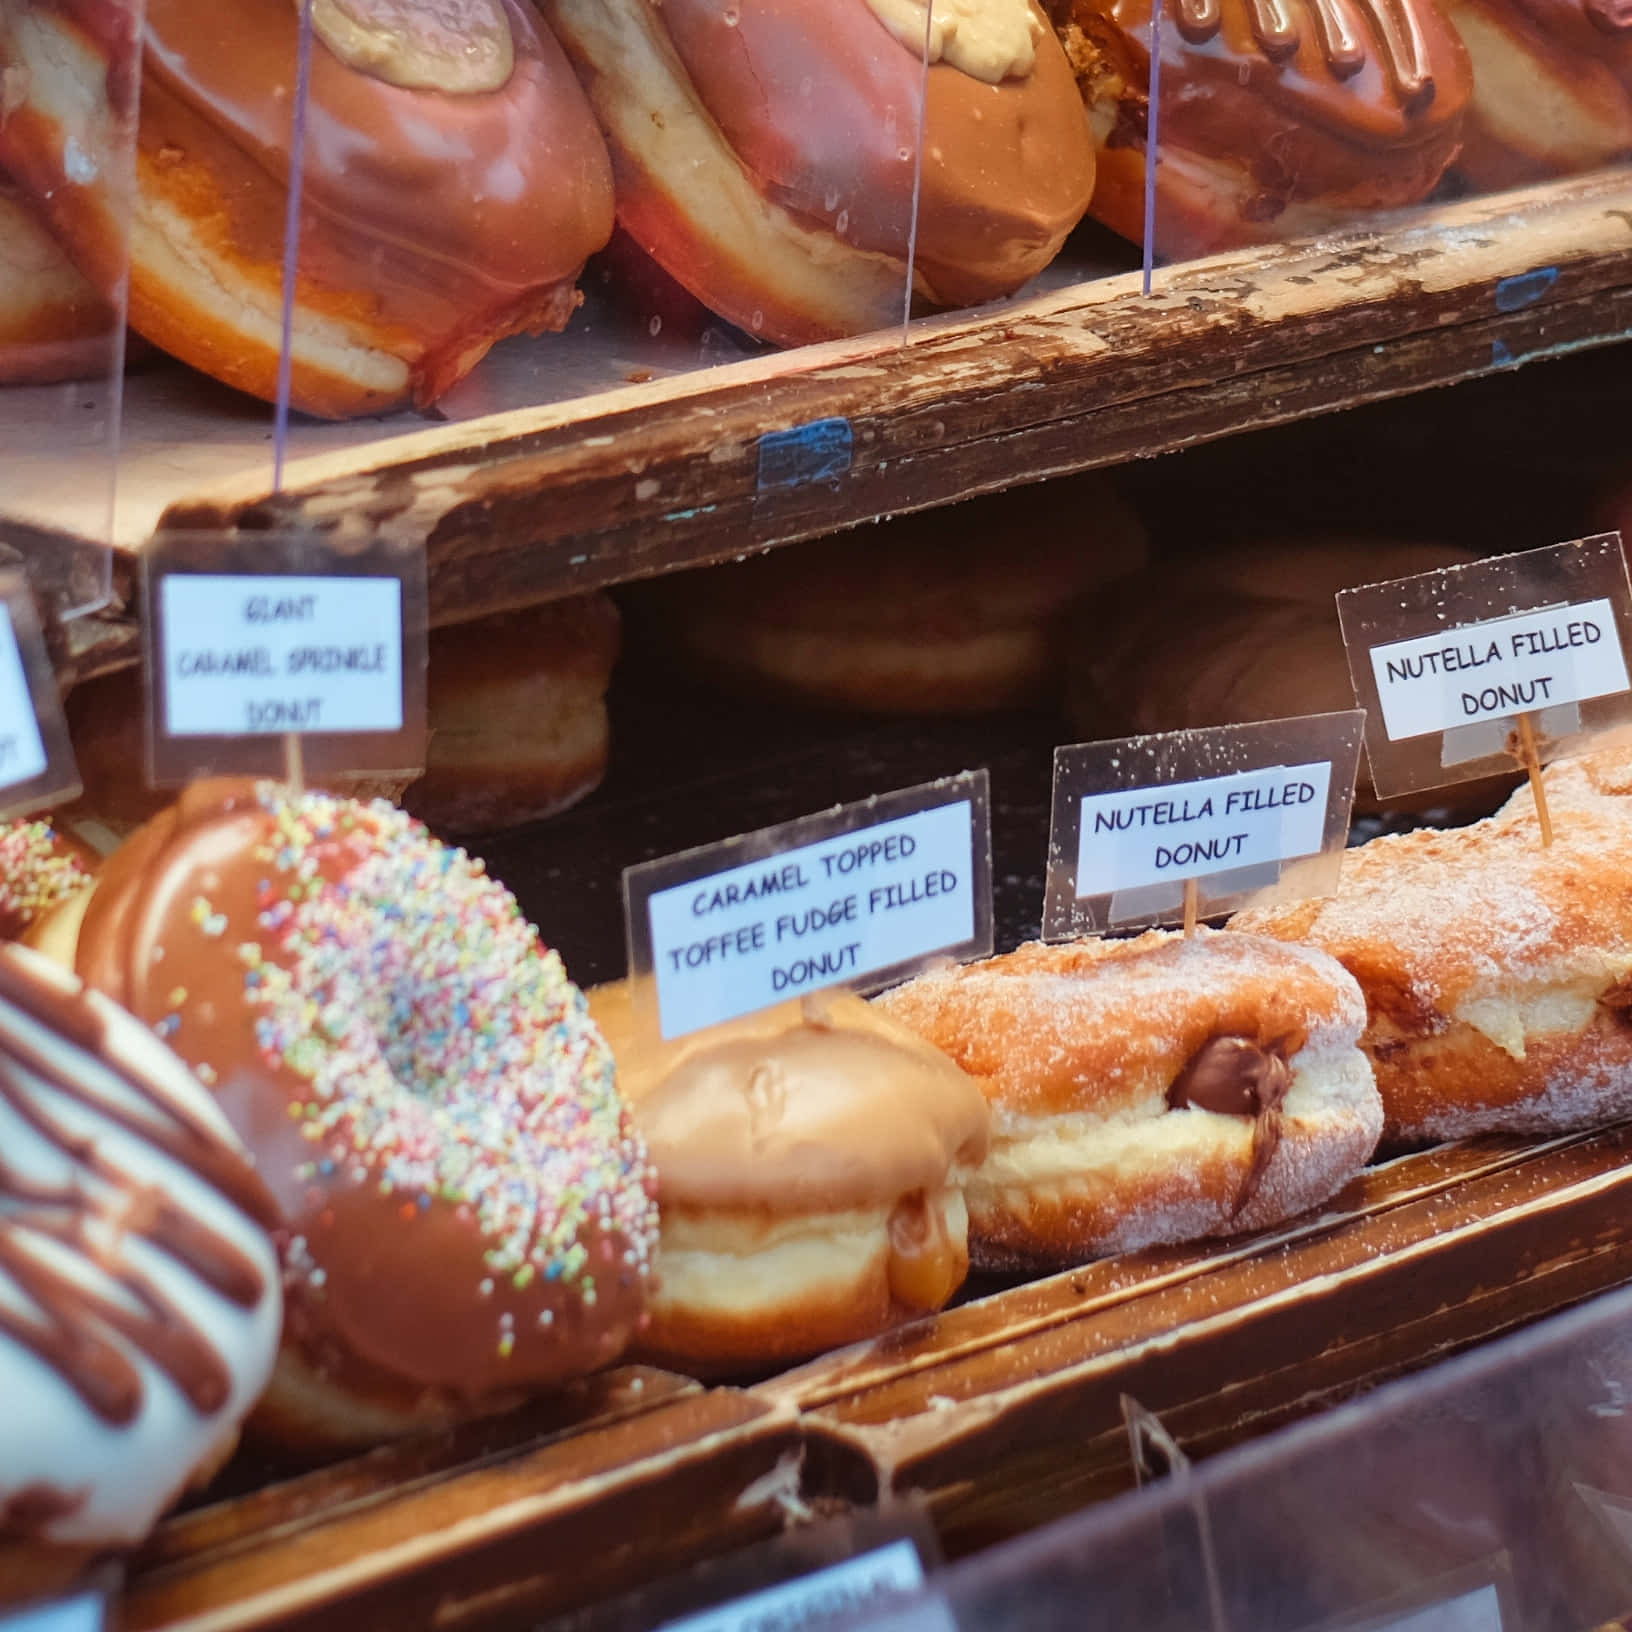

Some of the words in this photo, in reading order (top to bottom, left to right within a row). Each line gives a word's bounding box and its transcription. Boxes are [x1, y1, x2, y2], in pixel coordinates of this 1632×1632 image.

[244, 594, 318, 623] GIANT
[177, 646, 273, 679] CARAMEL
[1386, 641, 1503, 684] NUTELLA
[1511, 621, 1601, 658] FILLED
[245, 697, 323, 730] DONUT
[1461, 677, 1552, 716] DONUT
[1094, 797, 1214, 835] NUTELLA
[1225, 782, 1316, 815] FILLED
[1155, 834, 1249, 869] DONUT
[692, 863, 810, 917] CARAMEL
[820, 833, 917, 879] TOPPED
[669, 923, 765, 974] TOFFEE
[776, 895, 858, 943] FUDGE
[868, 869, 957, 914] FILLED
[772, 942, 862, 993] DONUT
